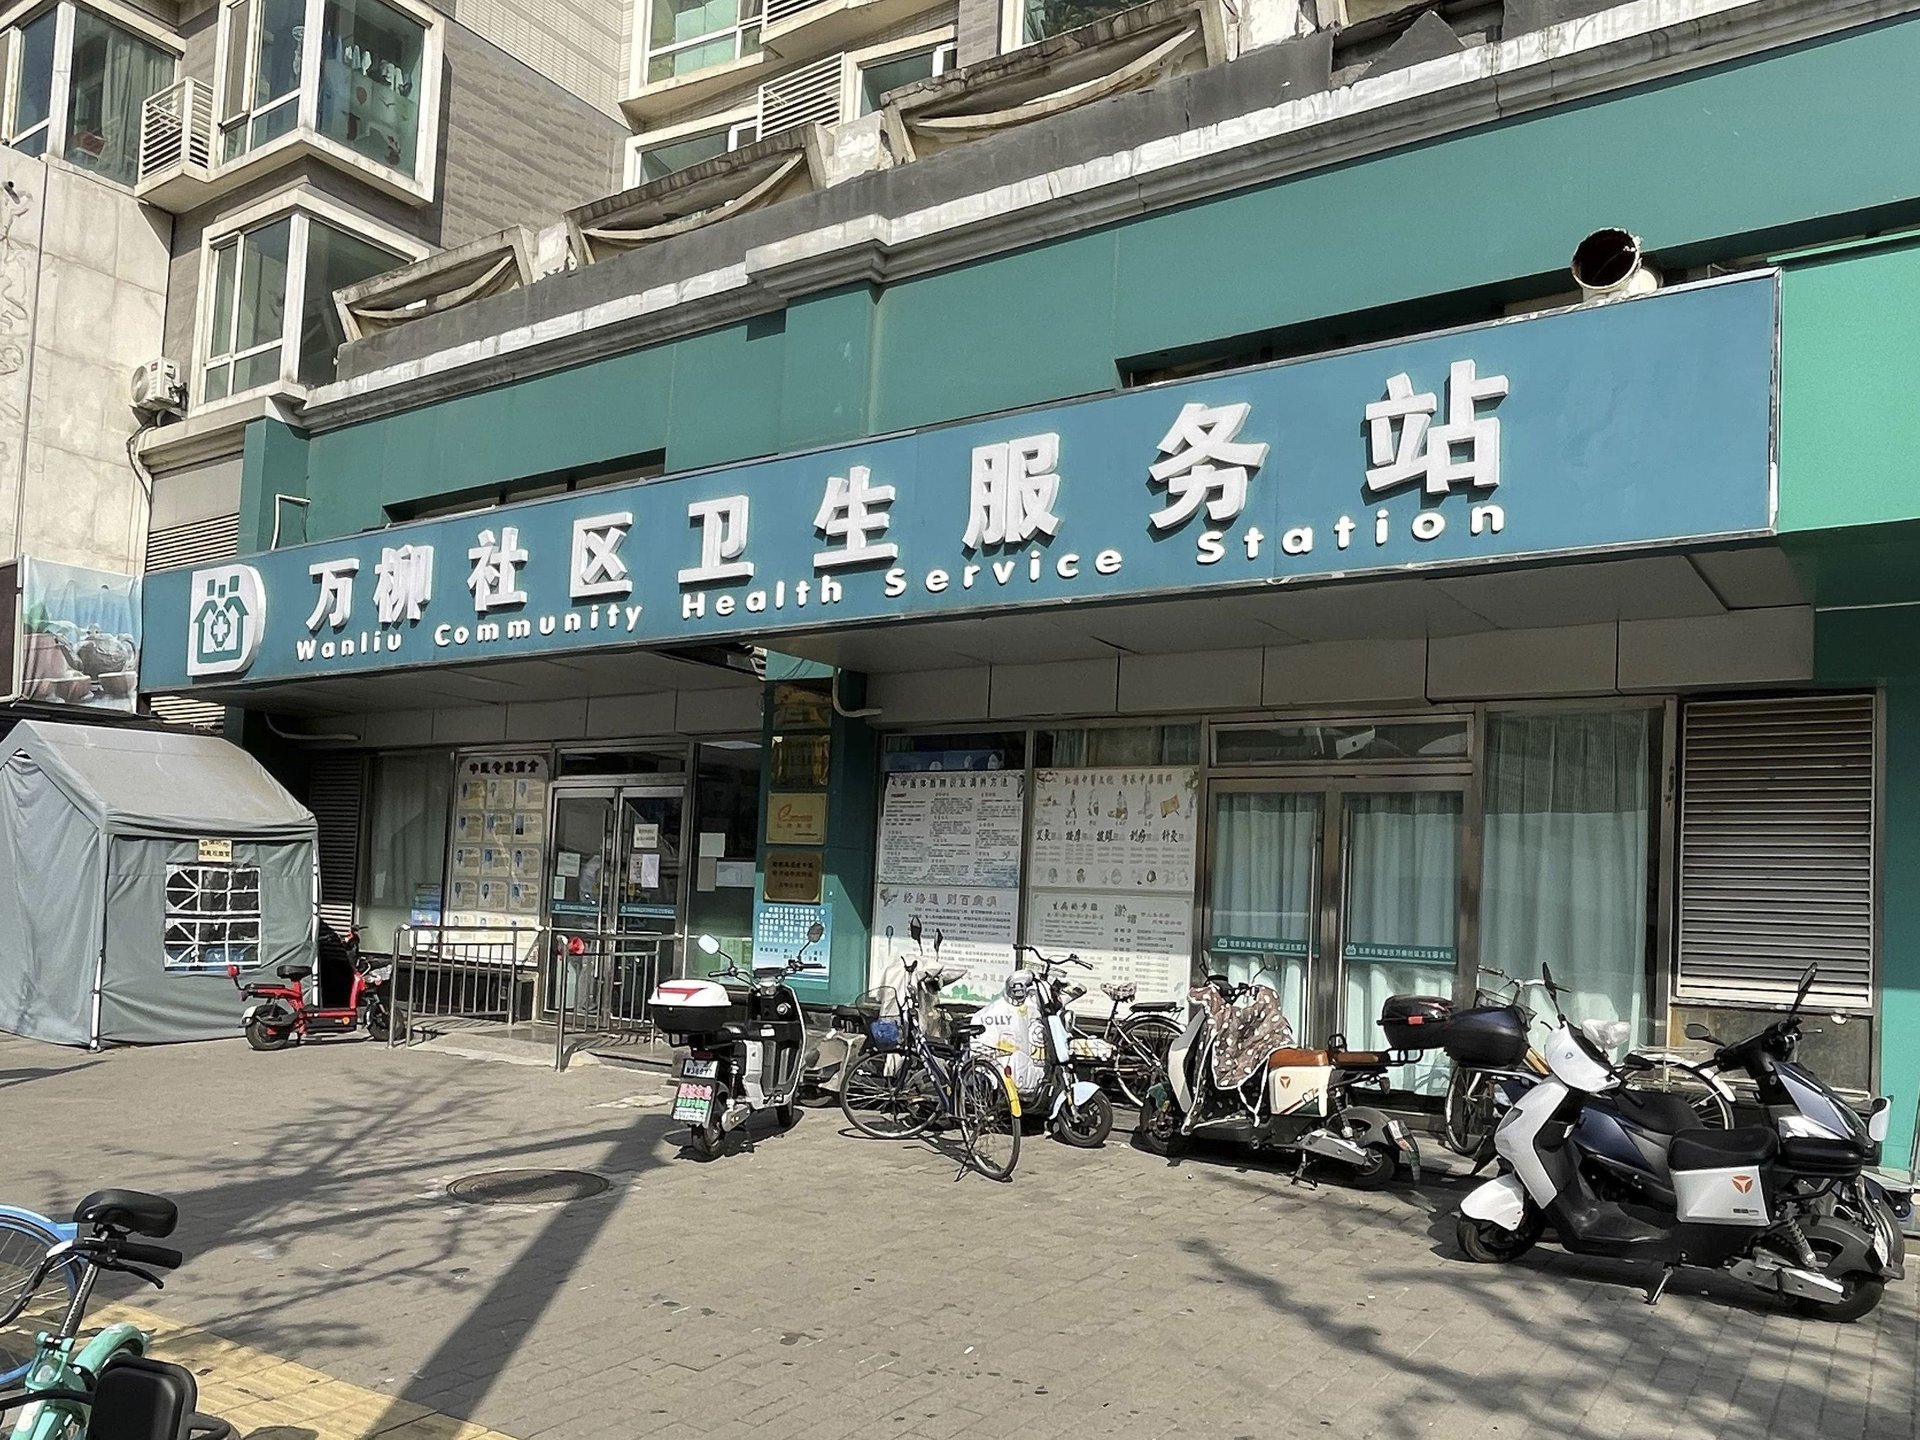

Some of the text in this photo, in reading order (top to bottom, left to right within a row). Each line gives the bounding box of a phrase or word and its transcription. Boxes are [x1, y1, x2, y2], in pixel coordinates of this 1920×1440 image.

[296, 502, 1505, 662] Wanliu Community Health Service Station
[305, 358, 1510, 632] 万柳社区卫生服务站
